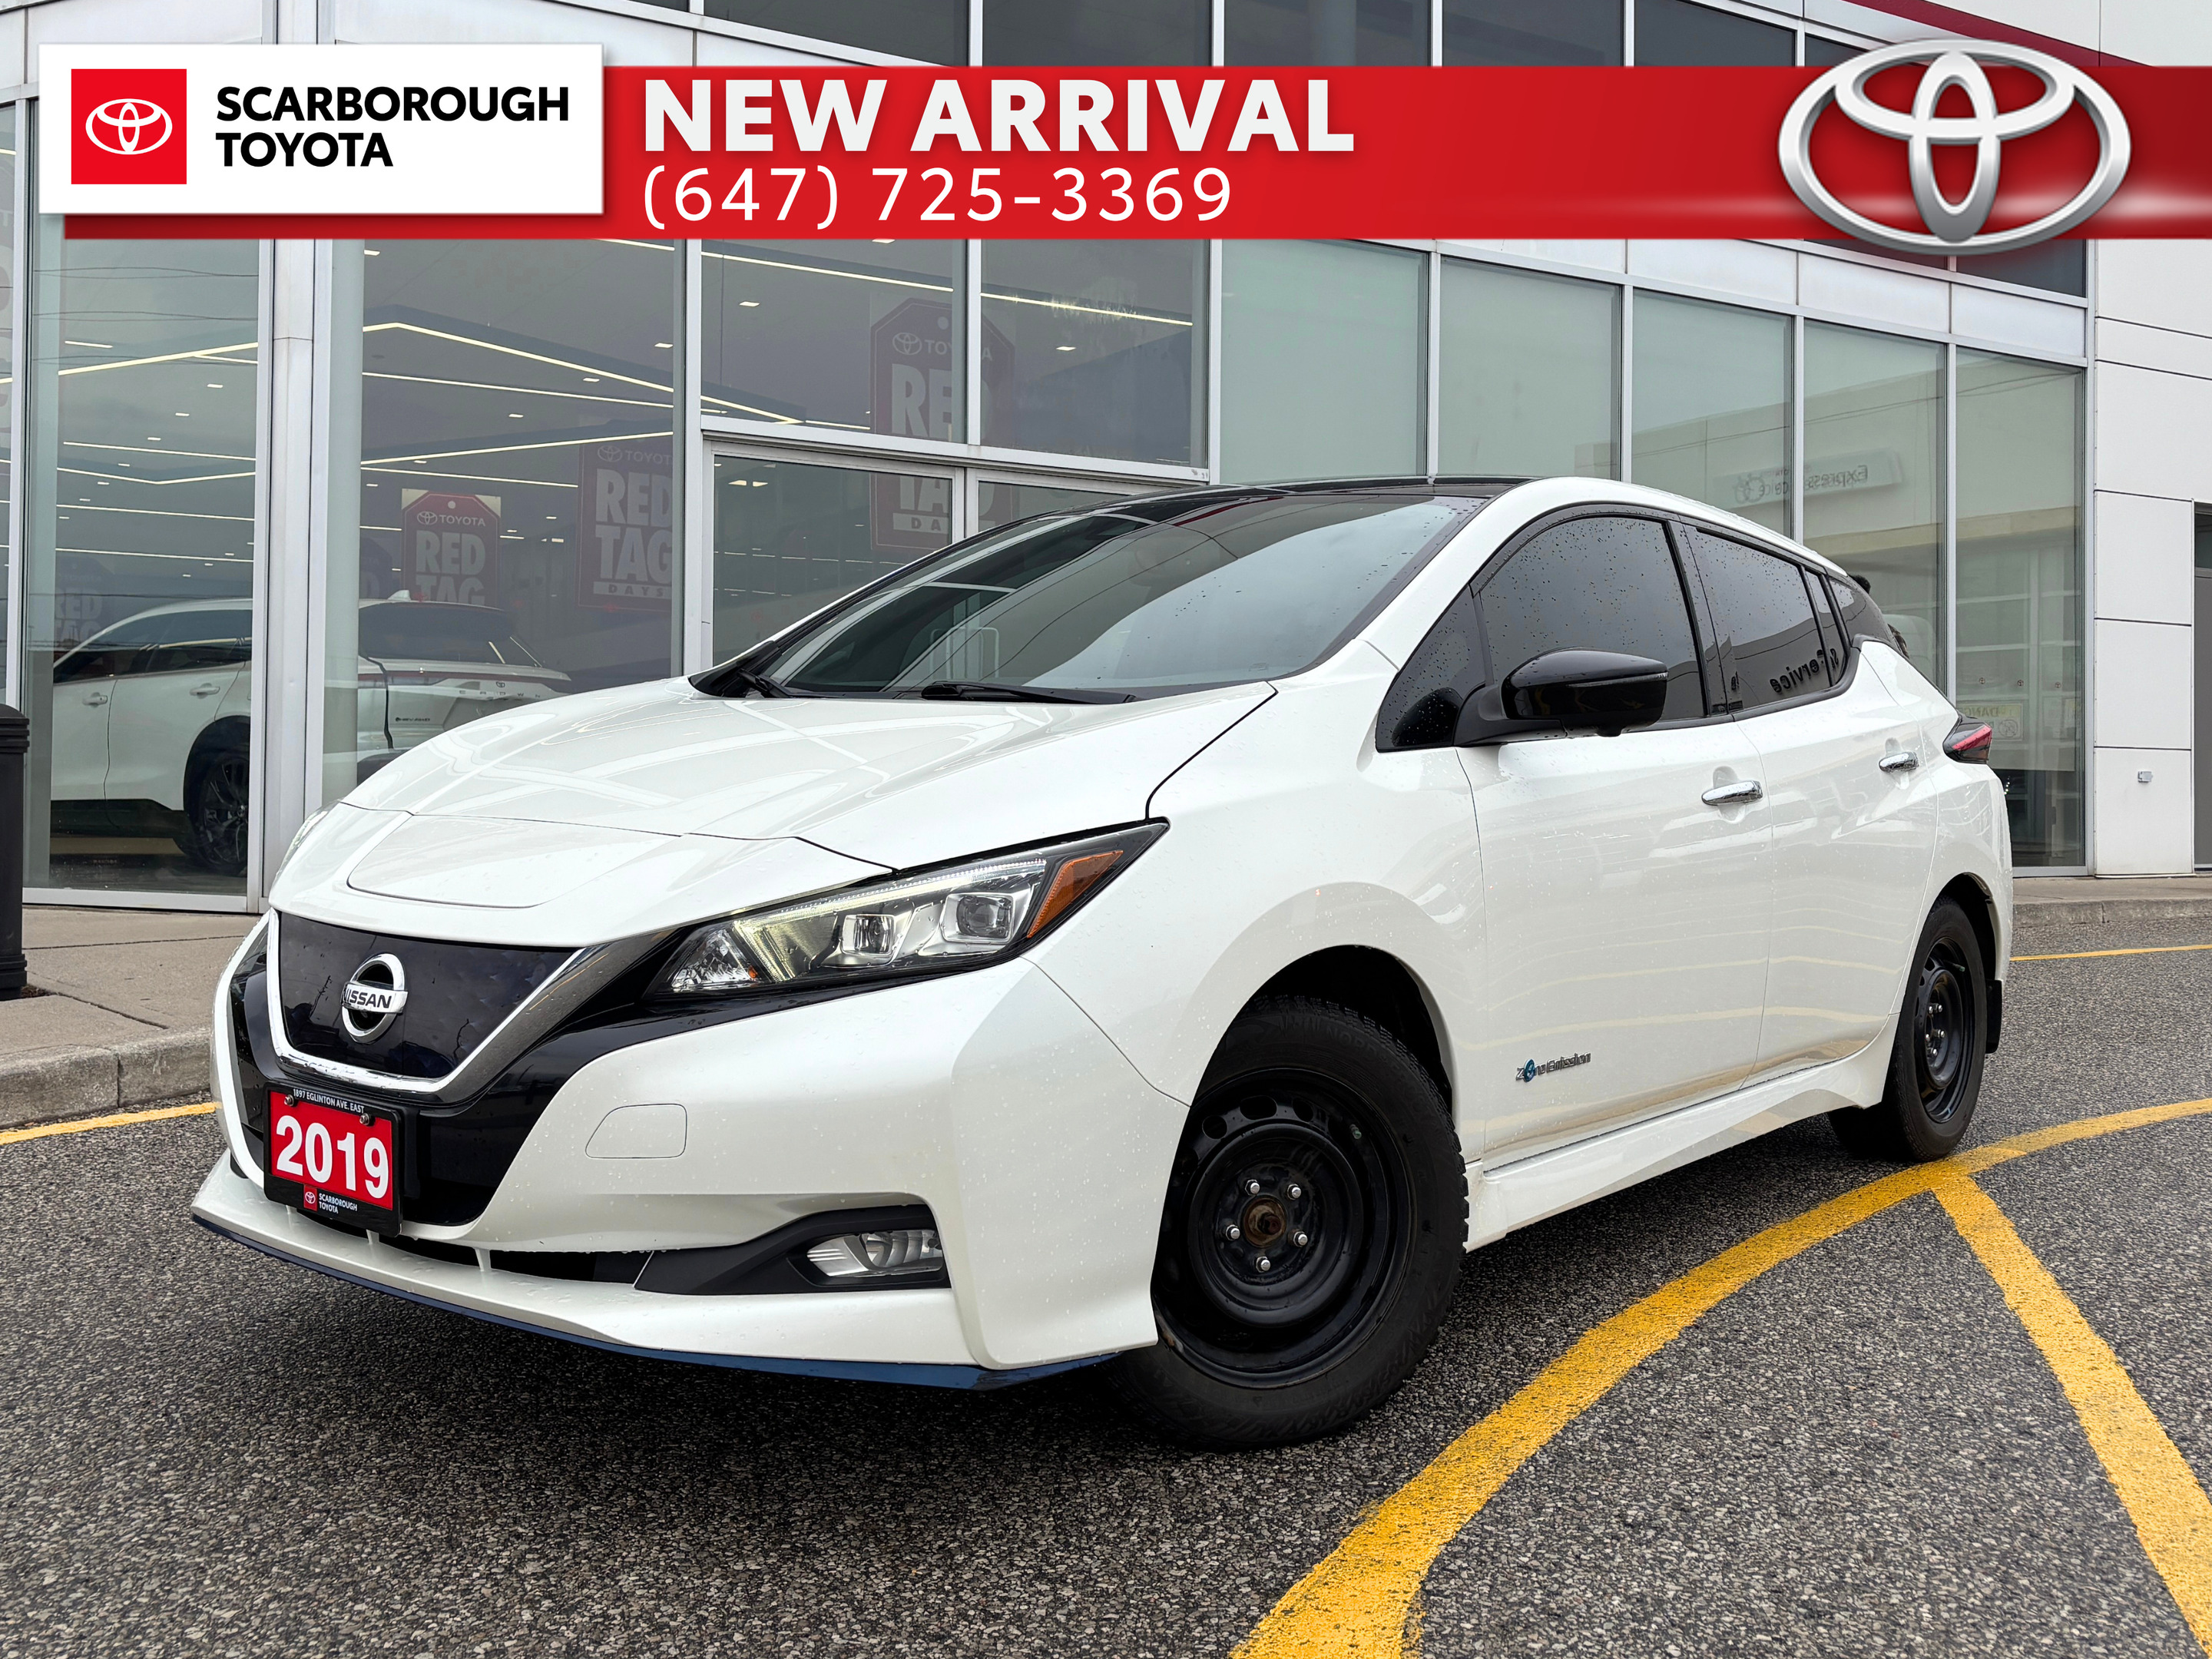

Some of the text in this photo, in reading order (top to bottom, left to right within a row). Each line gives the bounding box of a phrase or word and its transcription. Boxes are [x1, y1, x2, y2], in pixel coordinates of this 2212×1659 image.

[624, 450, 674, 465] TOYOT
[596, 468, 673, 528] RED
[439, 514, 486, 527] TOYOTA
[416, 529, 485, 575] RED
[595, 525, 673, 584] TAG
[608, 584, 664, 598] DAYS
[343, 988, 392, 1008] NISSAN
[293, 1088, 365, 1114] 1897 EGLINTON AVE. EAST
[276, 1114, 389, 1199] 2019
[319, 1193, 358, 1212] SCARBOROUGH
[319, 1201, 339, 1214] TOYOTA
